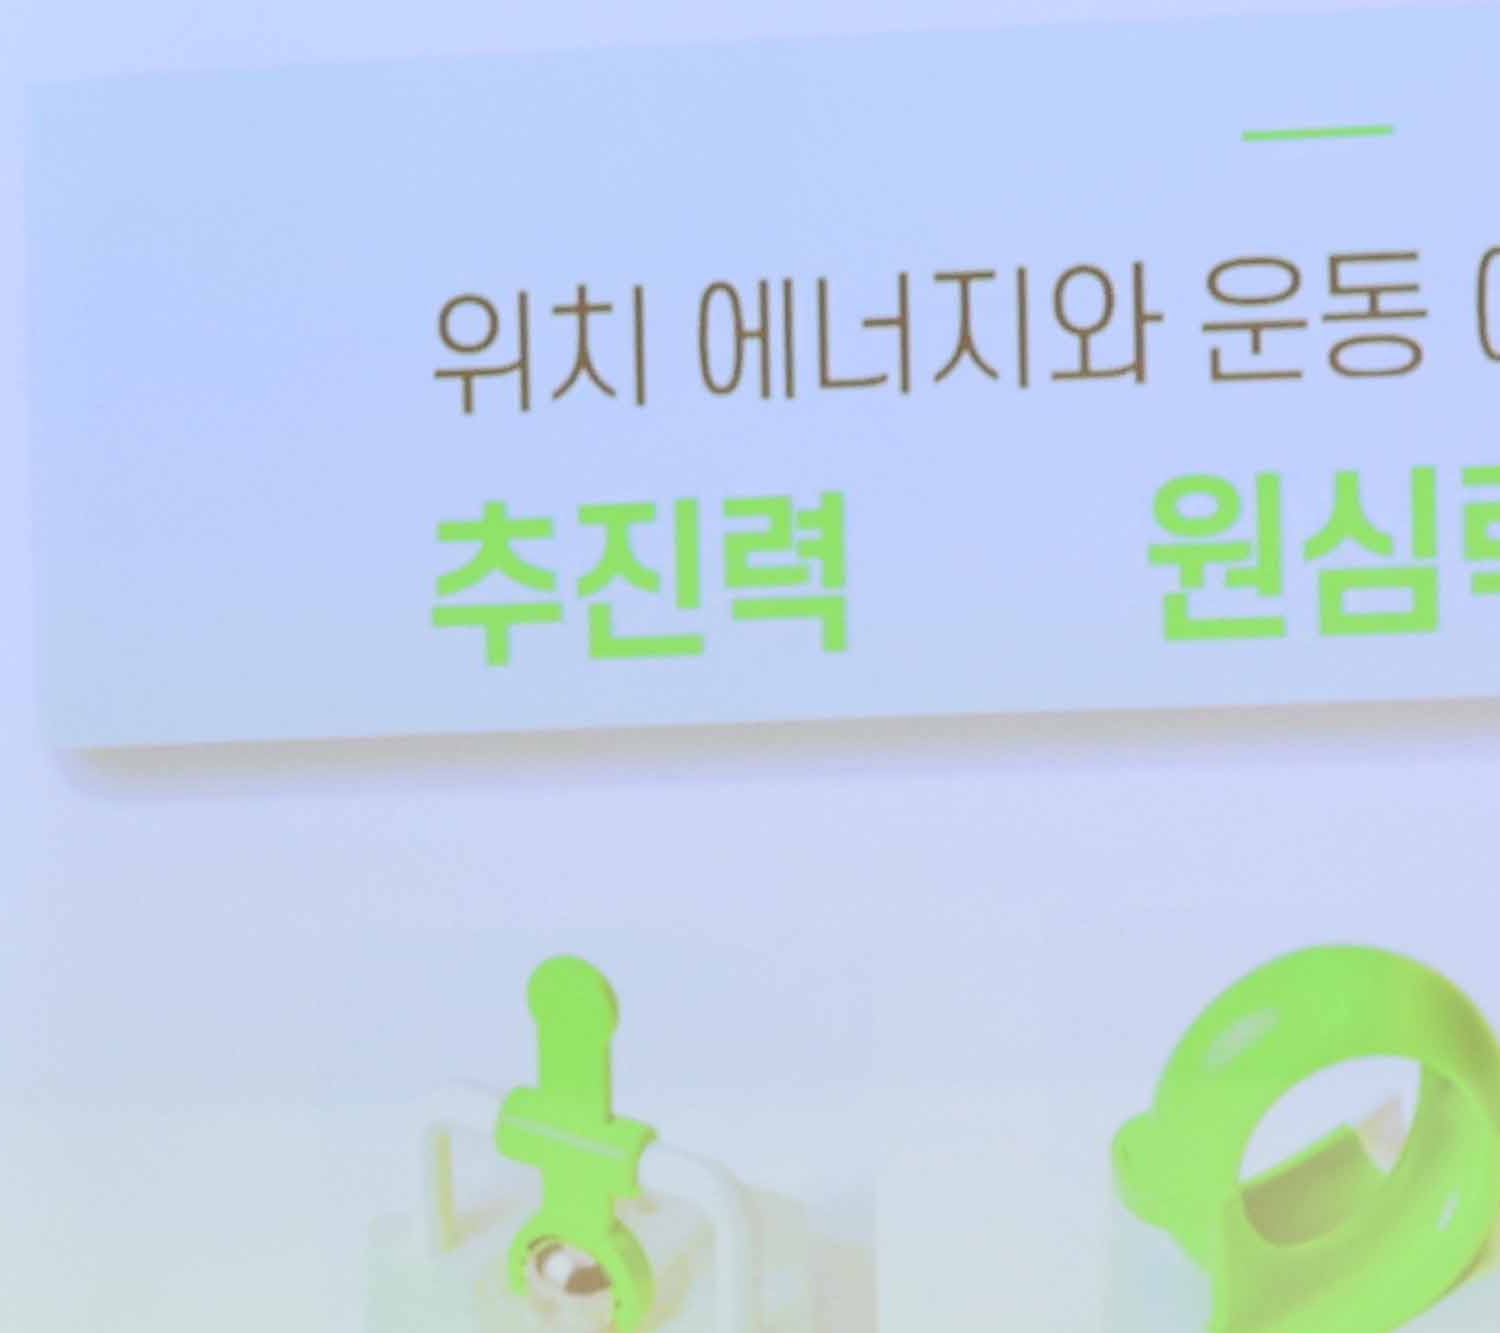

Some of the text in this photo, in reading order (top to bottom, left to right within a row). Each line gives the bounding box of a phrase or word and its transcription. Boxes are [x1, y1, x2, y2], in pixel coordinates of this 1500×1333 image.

[433, 283, 646, 415] 위치
[698, 260, 1164, 400] 에너지와
[1200, 250, 1429, 383] 운동
[430, 491, 848, 667] 추진력
